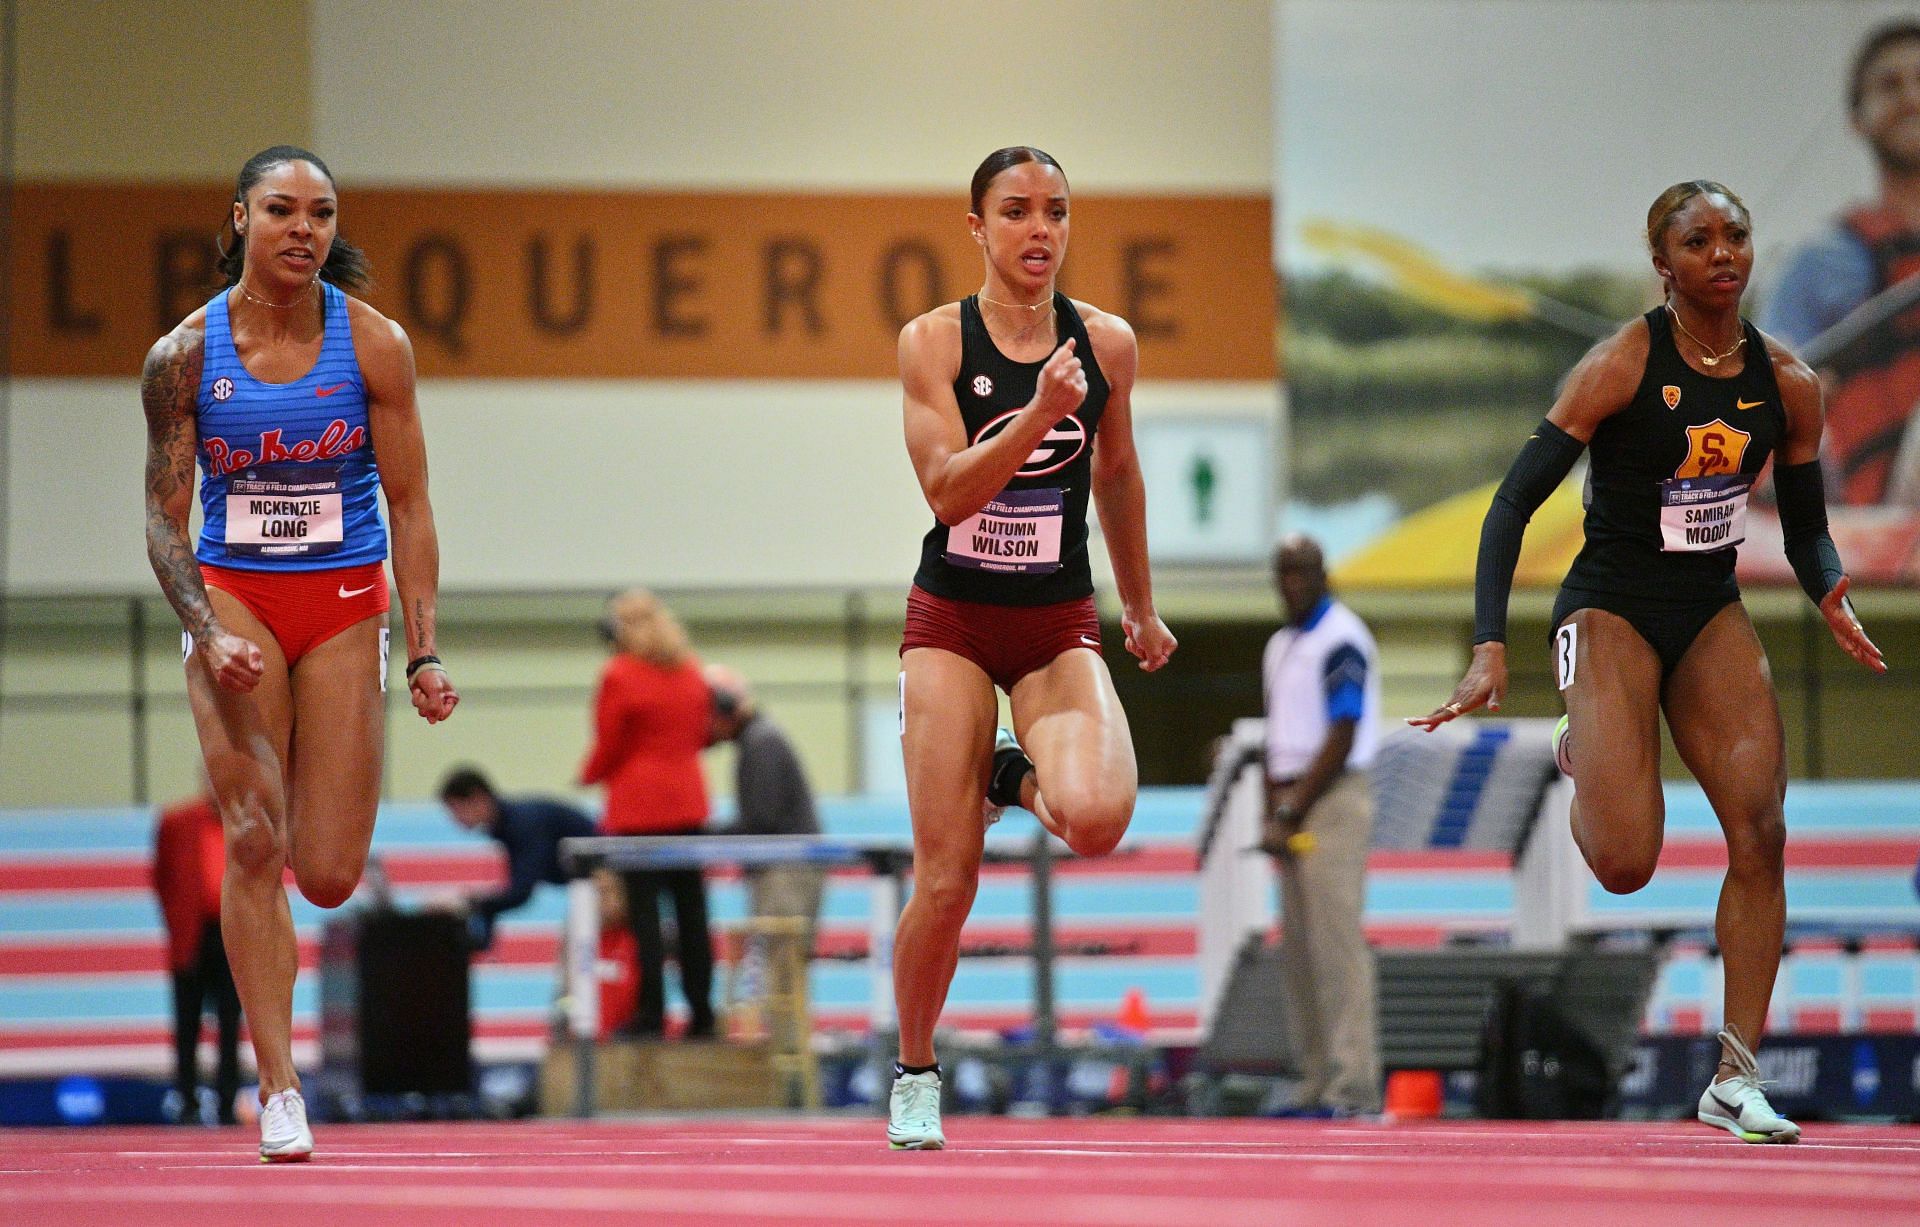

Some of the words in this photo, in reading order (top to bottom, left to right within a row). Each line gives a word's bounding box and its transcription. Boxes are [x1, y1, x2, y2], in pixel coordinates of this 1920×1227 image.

[213, 378, 234, 400] SEC
[973, 376, 993, 396] SEC
[203, 418, 366, 478] Rebels
[271, 484, 287, 492] FIELD
[1681, 492, 1699, 501] TRACK
[250, 499, 321, 517] MCKENZIE
[996, 505, 1013, 513] FIELD
[1013, 504, 1060, 513] CHAMPIONSHIPS
[1684, 502, 1735, 524] SAMIRAH
[261, 520, 308, 539] LONG
[978, 518, 1037, 537] AUTUMN
[1686, 520, 1732, 545] MOODY
[971, 534, 1039, 558] WILSON
[1560, 629, 1571, 685] 3
